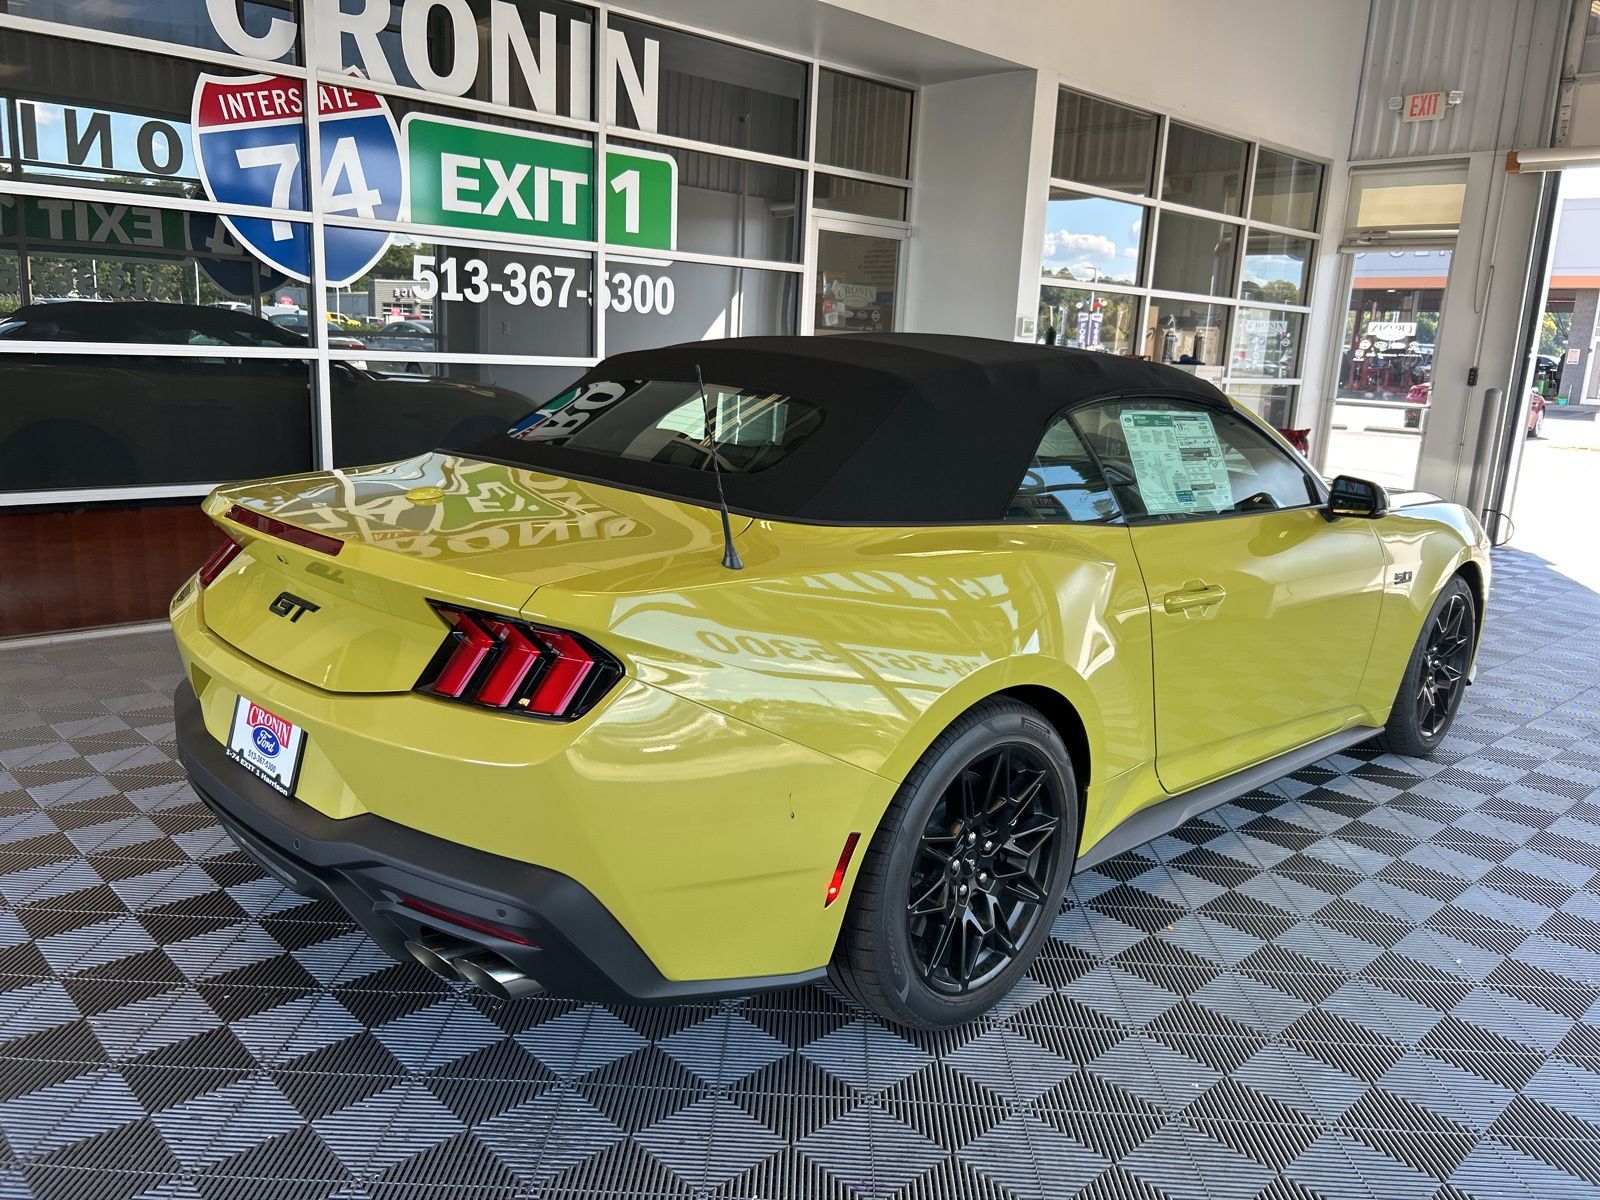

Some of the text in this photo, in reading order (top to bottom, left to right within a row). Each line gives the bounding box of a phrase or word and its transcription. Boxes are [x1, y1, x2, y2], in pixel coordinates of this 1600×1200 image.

[206, 0, 660, 132] CRONIN
[217, 85, 359, 121] INTERSATE
[1409, 93, 1441, 117] EXIT
[235, 136, 383, 242] 74
[440, 153, 642, 234] EXIT 1
[411, 254, 675, 316] 513-367-5300
[268, 591, 322, 623] GT
[249, 706, 290, 747] CRONIN
[256, 729, 276, 753] Ford
[240, 759, 256, 772] EXIT
[261, 773, 288, 796] Harrison
[248, 750, 277, 773] 513-367-5300
